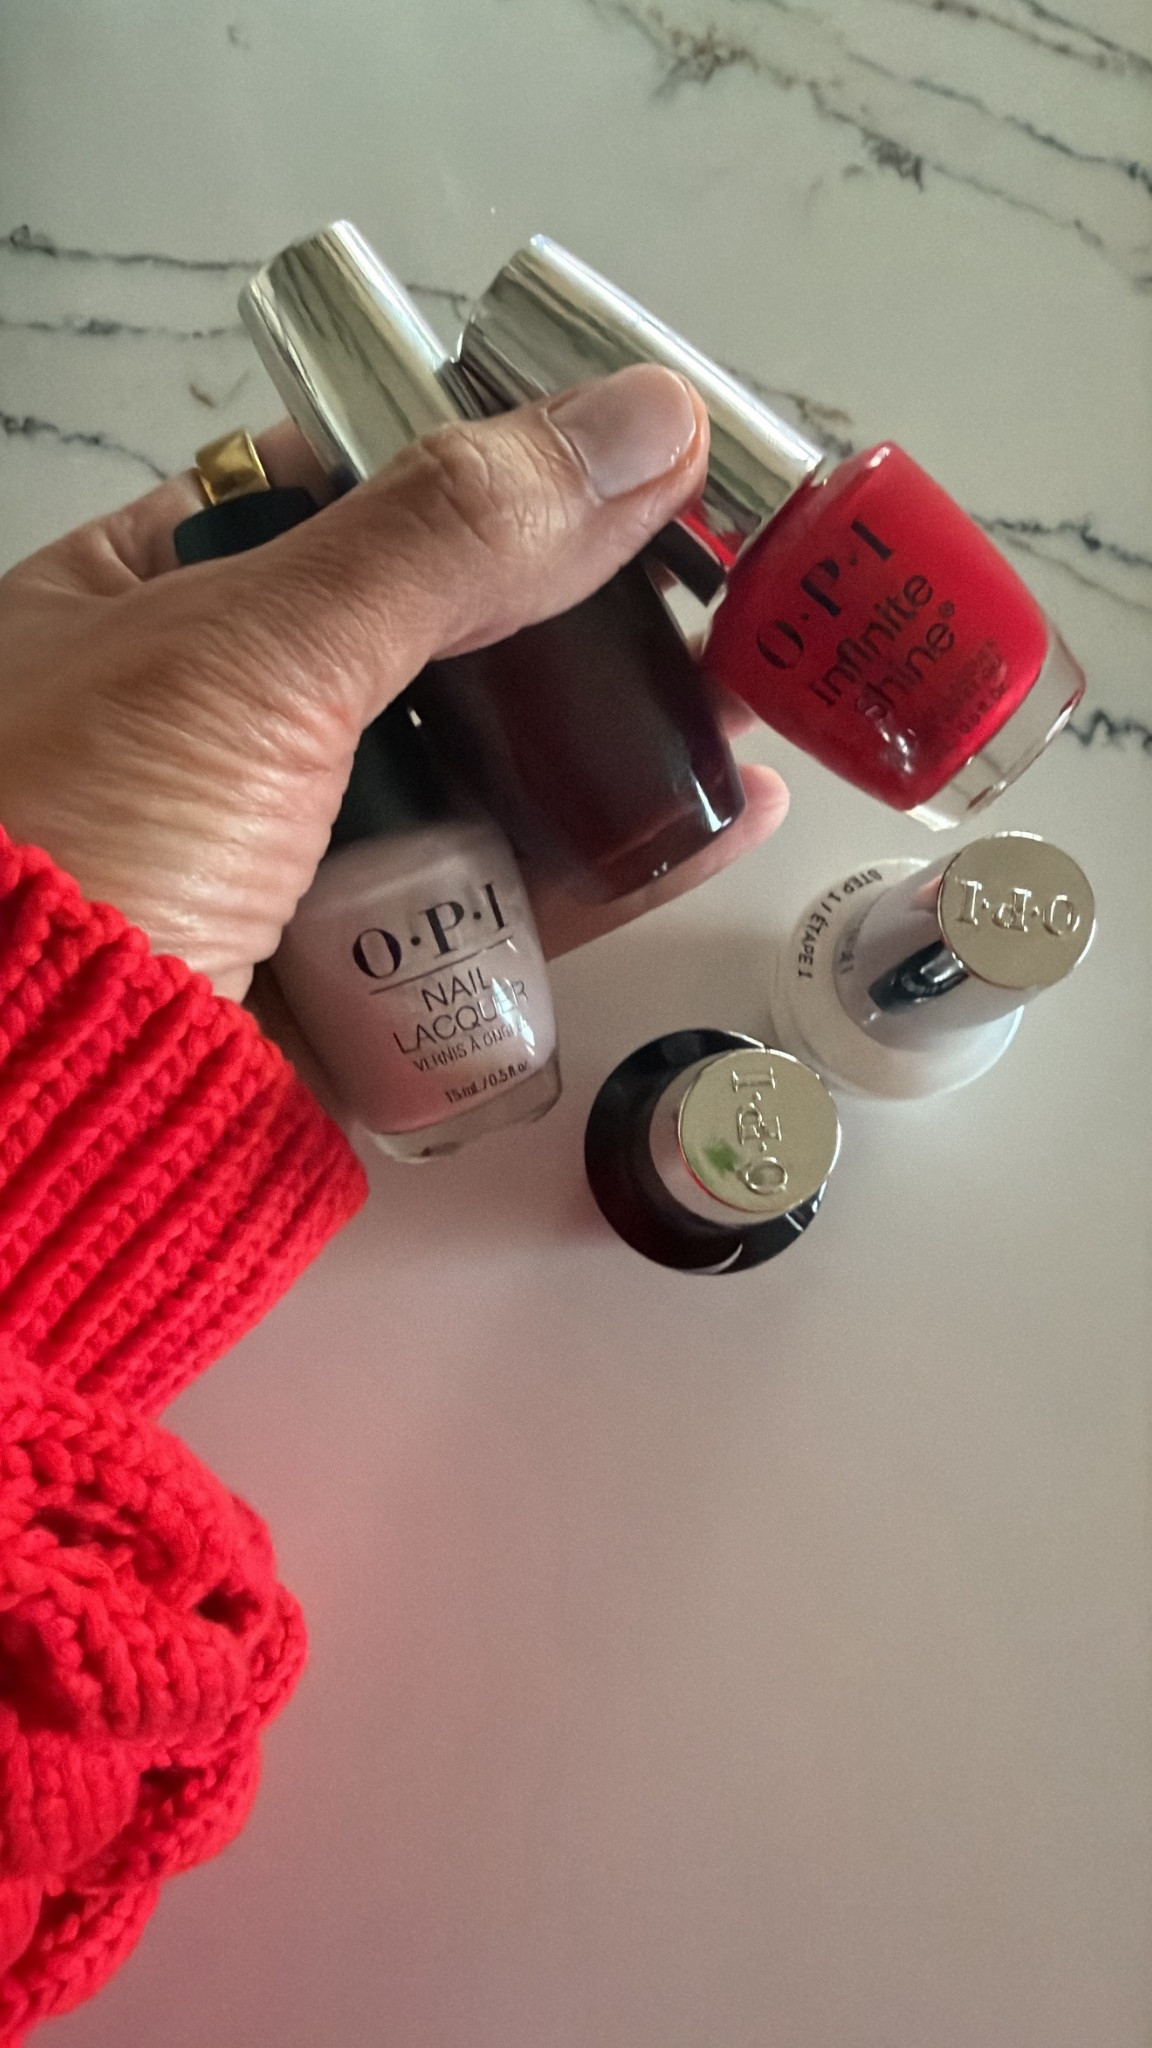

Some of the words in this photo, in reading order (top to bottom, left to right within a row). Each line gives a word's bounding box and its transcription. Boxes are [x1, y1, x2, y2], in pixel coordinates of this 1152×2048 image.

[843, 869, 882, 894] STEP
[828, 892, 841, 902] 1
[421, 967, 491, 1012] NAIL
[393, 981, 528, 1054] LACQUER
[413, 1043, 467, 1071] VERNIS
